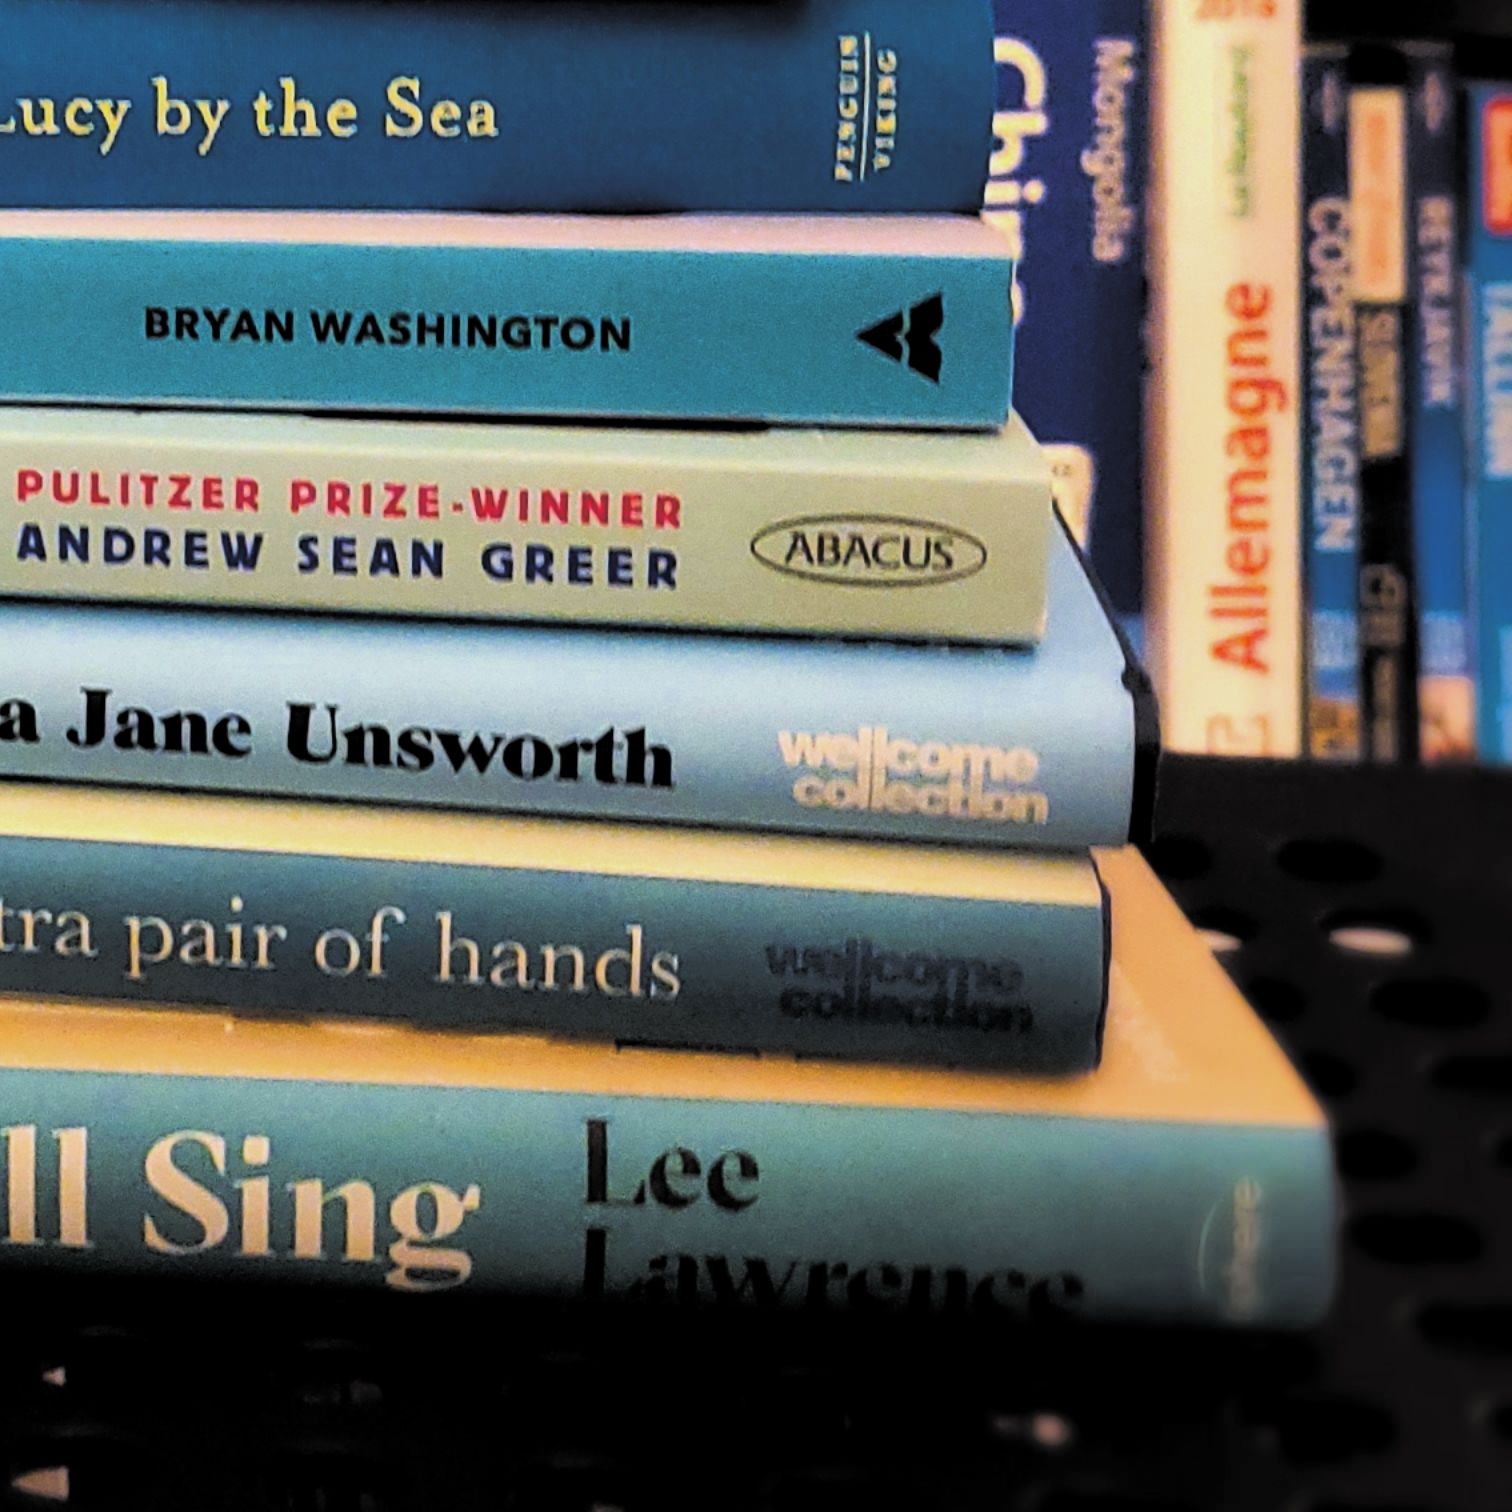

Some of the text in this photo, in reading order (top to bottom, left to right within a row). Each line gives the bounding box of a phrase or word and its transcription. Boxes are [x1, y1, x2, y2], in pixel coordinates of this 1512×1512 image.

[152, 75, 230, 156] by
[252, 77, 358, 139] the
[385, 74, 500, 140] Sea
[834, 34, 859, 181] PENGUIN
[873, 47, 898, 173] VIKING
[1080, 39, 1137, 265] Mongolia
[144, 307, 632, 352] BRYAN WASHINGTON
[1309, 196, 1356, 554] COPENHAGEN
[16, 469, 683, 529] PULITZER PRIZE-WINNER
[1206, 282, 1288, 676] Allemagne
[16, 523, 678, 588] ANDREW SEAN GREER
[785, 530, 954, 571] ABACUS
[66, 686, 253, 758] Jane
[287, 700, 676, 789] Unsworth
[777, 725, 1040, 784] wellcome
[791, 774, 1050, 825] collection
[124, 894, 289, 982] pair
[313, 905, 405, 979] of
[432, 910, 683, 1002] hands
[764, 938, 1025, 991] wellcome
[143, 1128, 483, 1292] Sing
[583, 1116, 761, 1211] Lee
